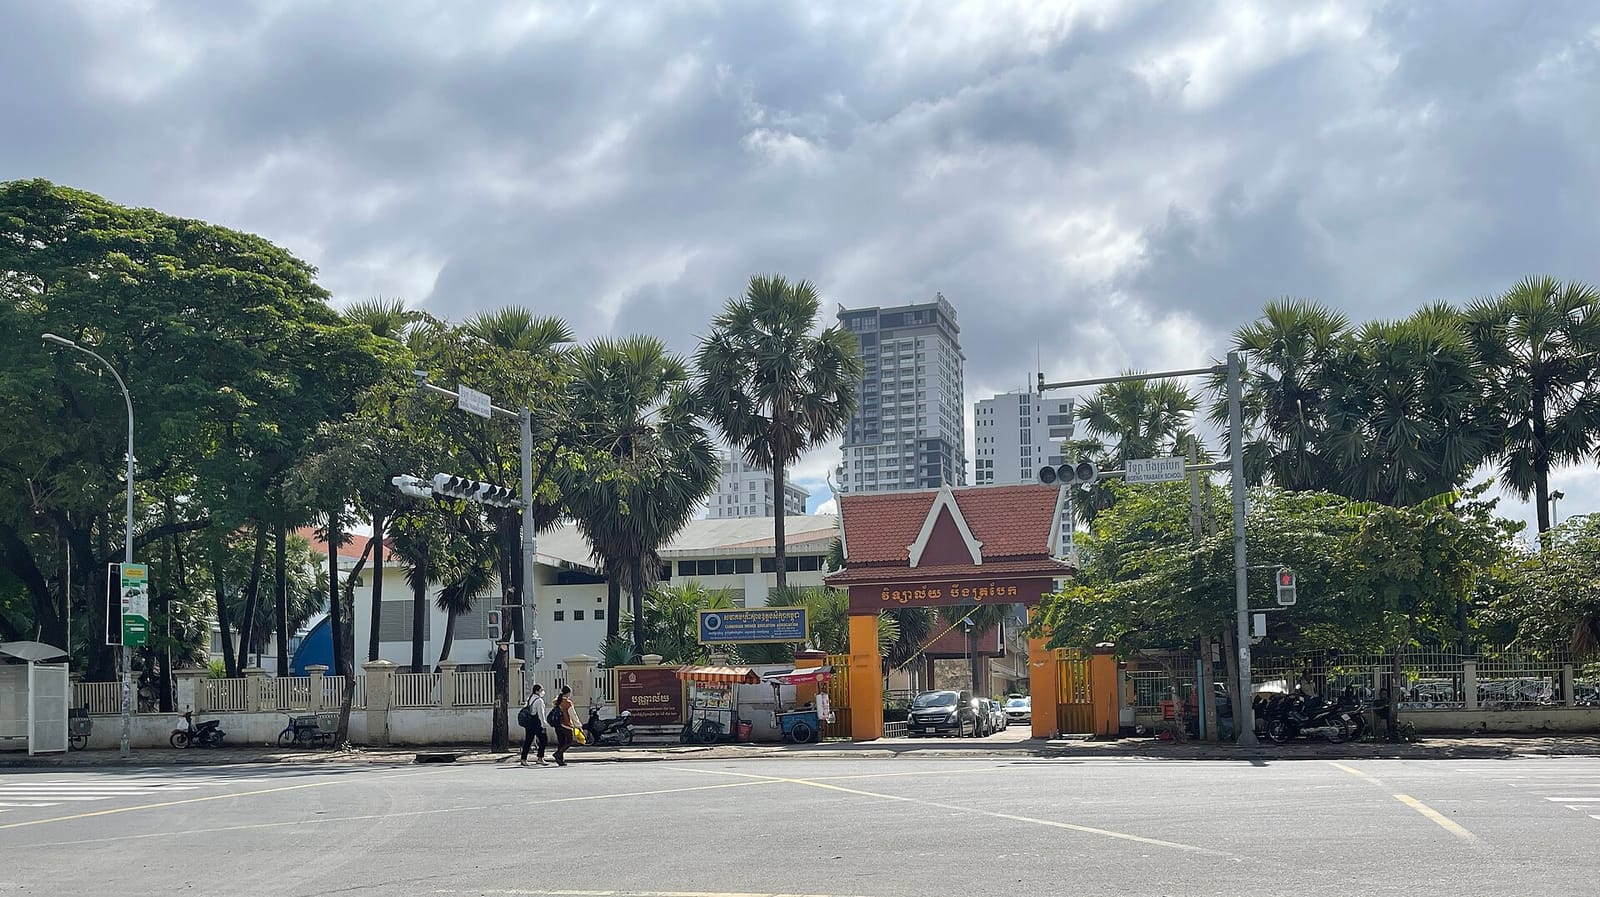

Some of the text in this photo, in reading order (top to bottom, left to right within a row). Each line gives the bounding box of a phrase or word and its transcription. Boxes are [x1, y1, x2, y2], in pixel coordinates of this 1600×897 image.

[881, 582, 1017, 603] វិទ្យាល័យ បឹងត្របែក
[631, 692, 670, 706] បណ្ណាល័យ
